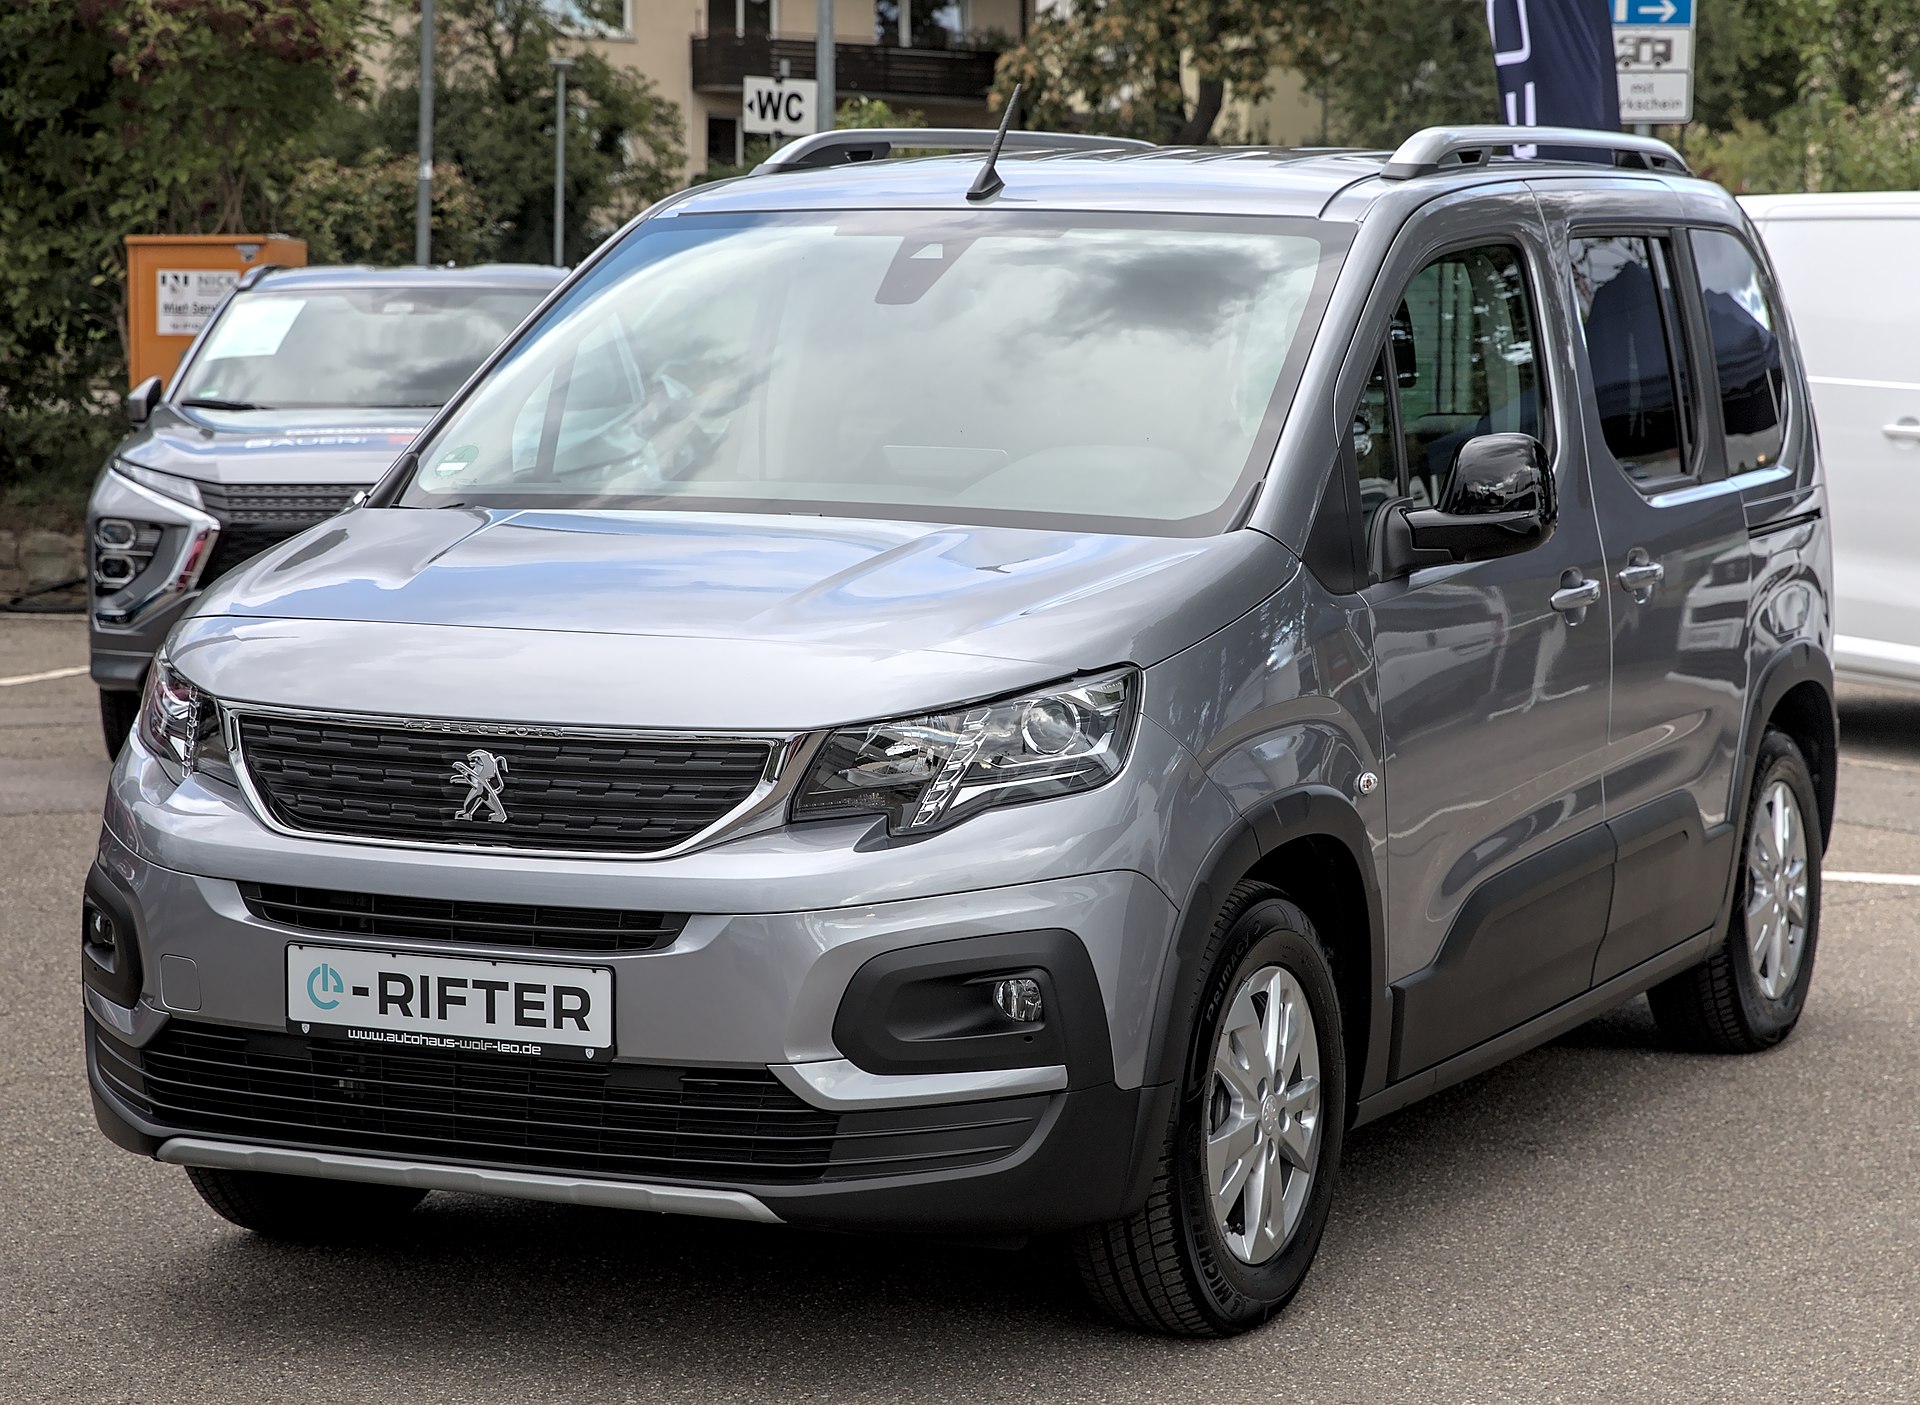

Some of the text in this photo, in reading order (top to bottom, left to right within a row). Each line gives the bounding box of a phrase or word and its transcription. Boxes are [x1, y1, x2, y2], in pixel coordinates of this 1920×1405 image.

[757, 91, 803, 122] WC
[1619, 98, 1682, 110] rkschein
[306, 963, 591, 1032] e-RIFTER
[347, 1029, 542, 1055] www.autohaus-wolf-leo.de
